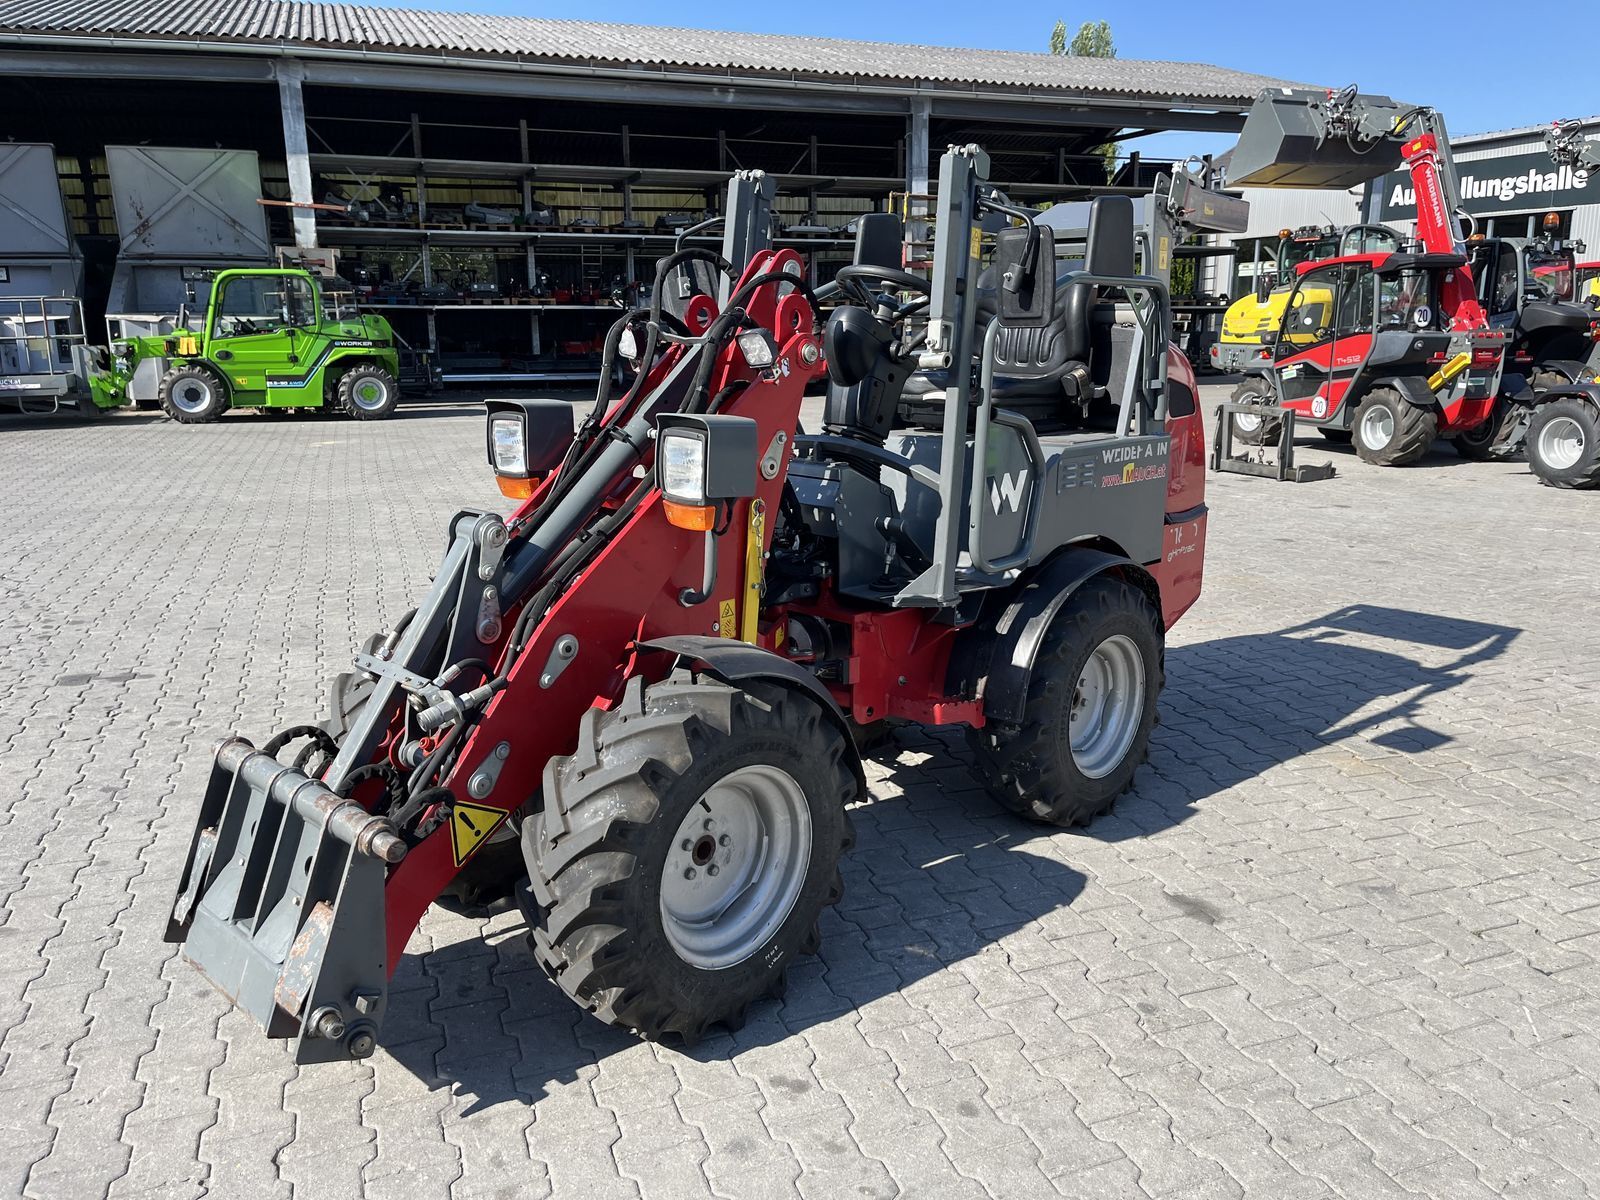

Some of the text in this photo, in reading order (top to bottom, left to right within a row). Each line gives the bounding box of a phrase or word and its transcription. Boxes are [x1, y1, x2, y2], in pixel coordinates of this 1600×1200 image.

[1388, 165, 1588, 206] Aullungshalle
[1424, 166, 1444, 228] WEIDEMANN
[1417, 309, 1428, 323] 20
[1314, 400, 1324, 414] 20
